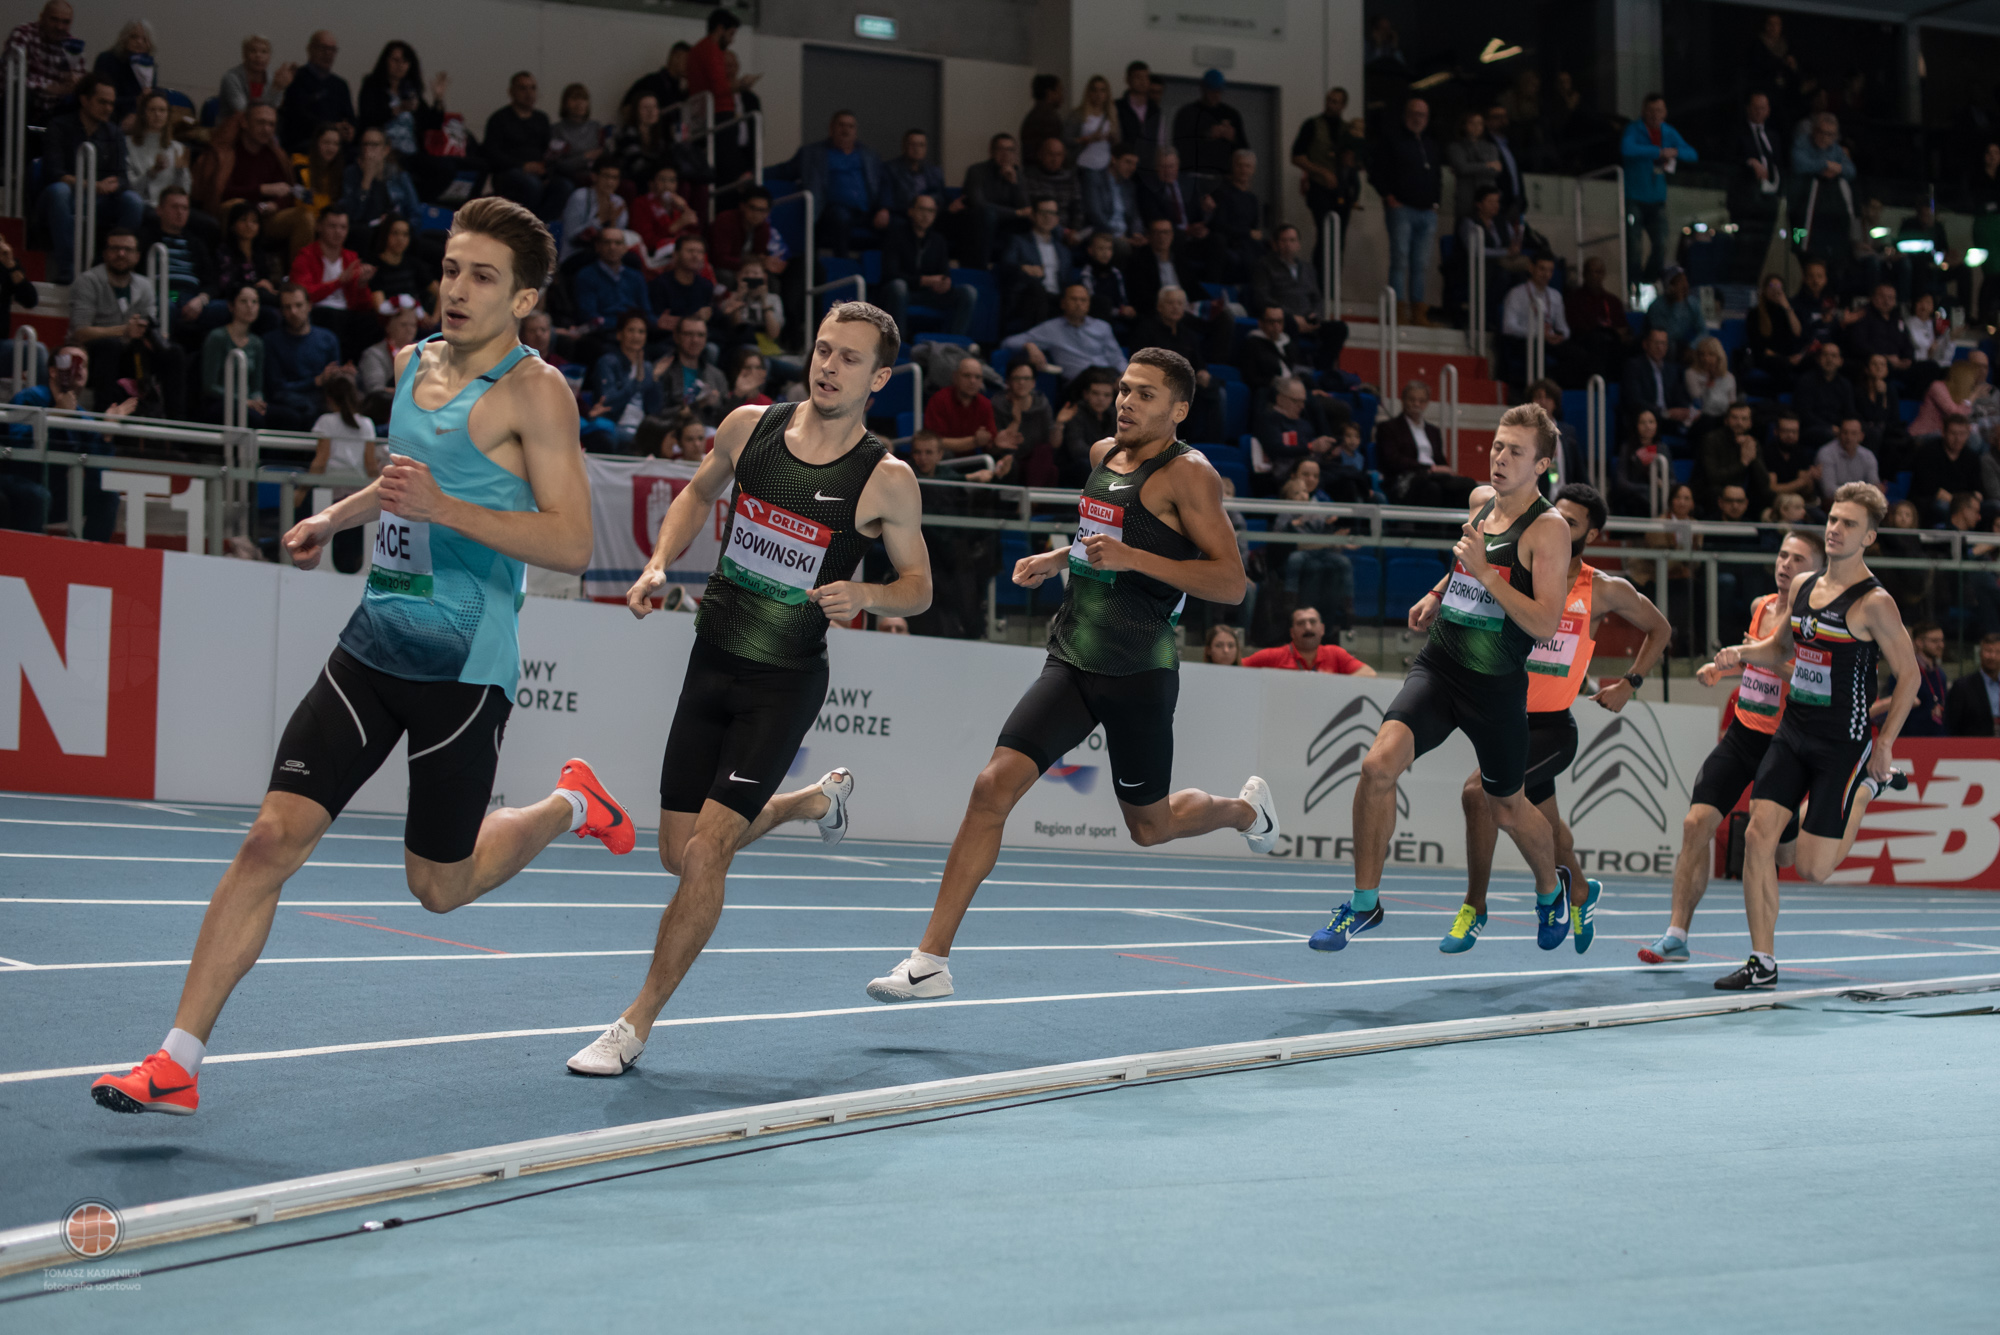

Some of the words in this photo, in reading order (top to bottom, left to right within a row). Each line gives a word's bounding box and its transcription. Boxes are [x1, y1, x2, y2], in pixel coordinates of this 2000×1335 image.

[1089, 504, 1112, 520] ORLEN
[771, 513, 815, 539] ORLEN
[734, 526, 817, 574] SOWINSKI
[735, 570, 760, 590] Toruń
[762, 583, 788, 599] 2019
[825, 687, 873, 709] AWY
[815, 713, 892, 737] MORZE
[1034, 820, 1072, 837] Region
[1074, 822, 1087, 836] of
[1088, 826, 1117, 839] sport
